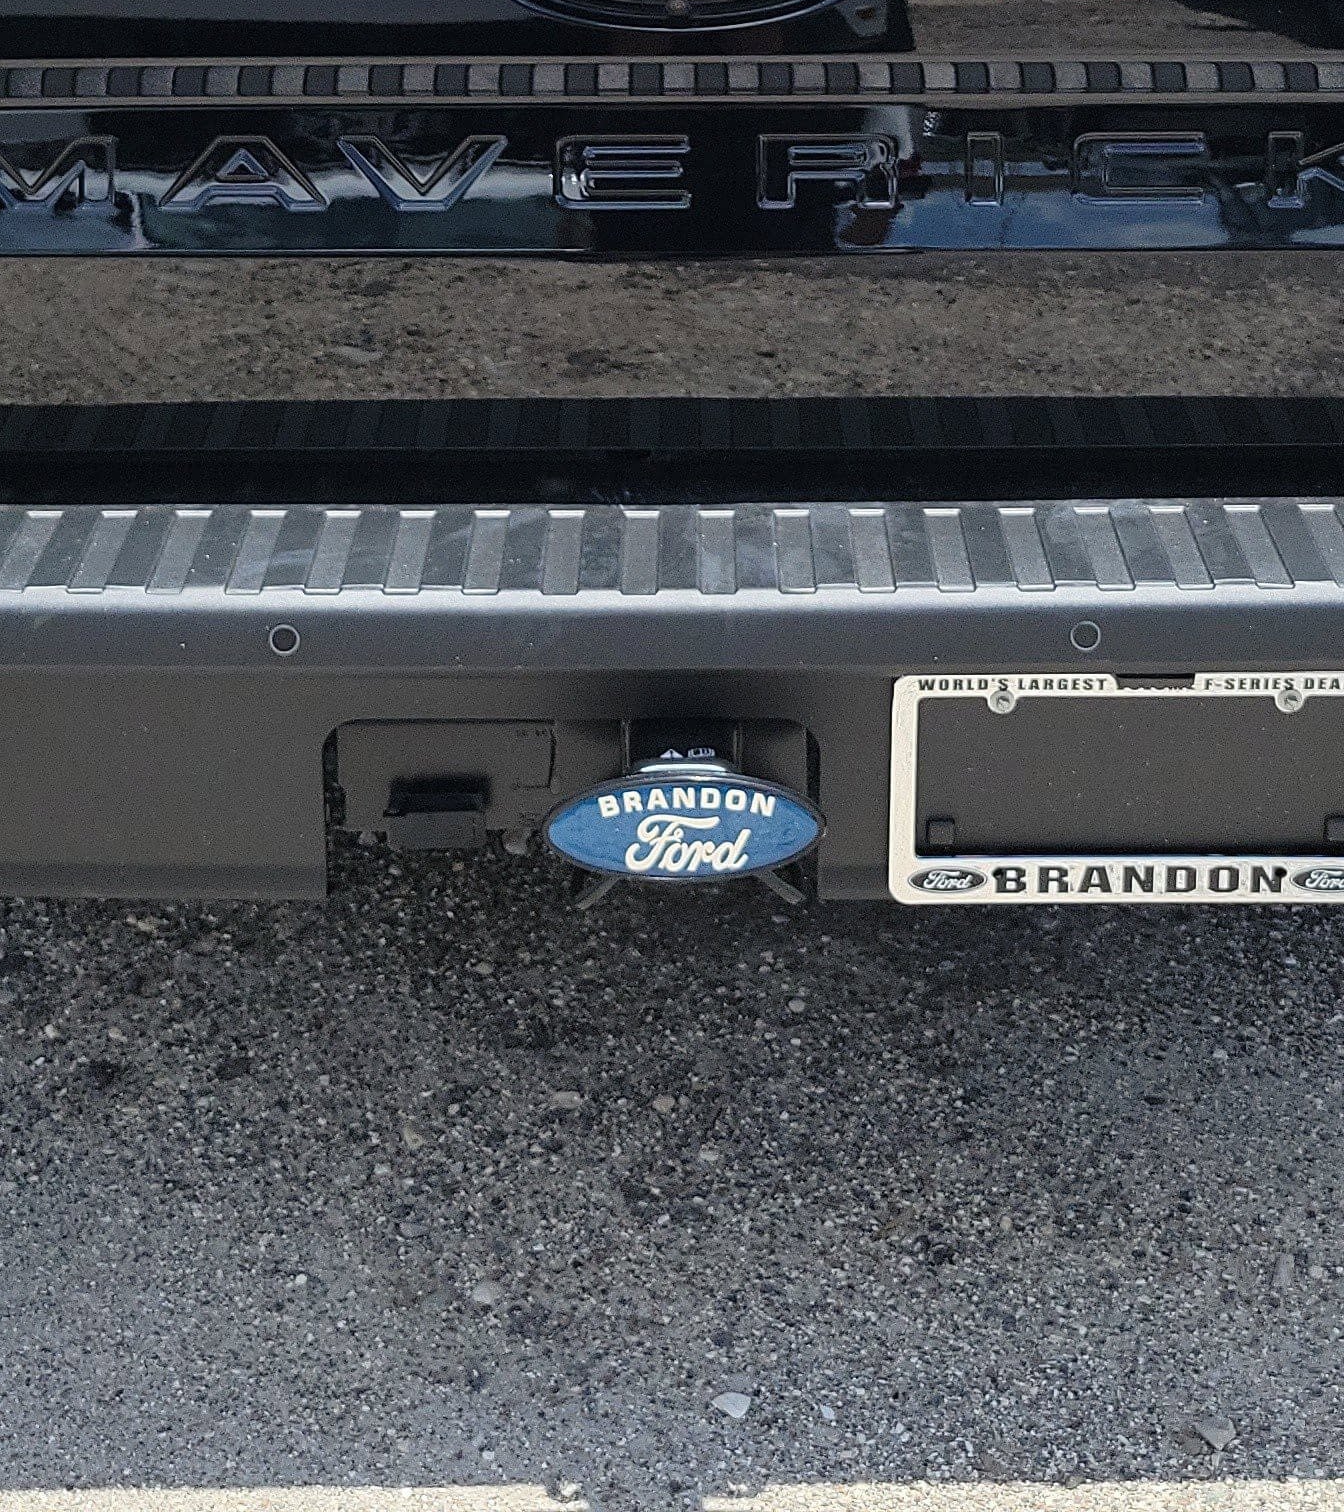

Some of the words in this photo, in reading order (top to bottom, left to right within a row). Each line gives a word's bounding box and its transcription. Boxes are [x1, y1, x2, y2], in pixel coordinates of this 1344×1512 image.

[918, 677, 1010, 692] WORLD'S
[1017, 677, 1108, 691] LARGEST
[1205, 677, 1296, 691] F-SERIES
[597, 787, 776, 819] BRANDON
[624, 813, 753, 873] Ford
[922, 869, 974, 890] Ford
[992, 865, 1289, 894] BRANDON
